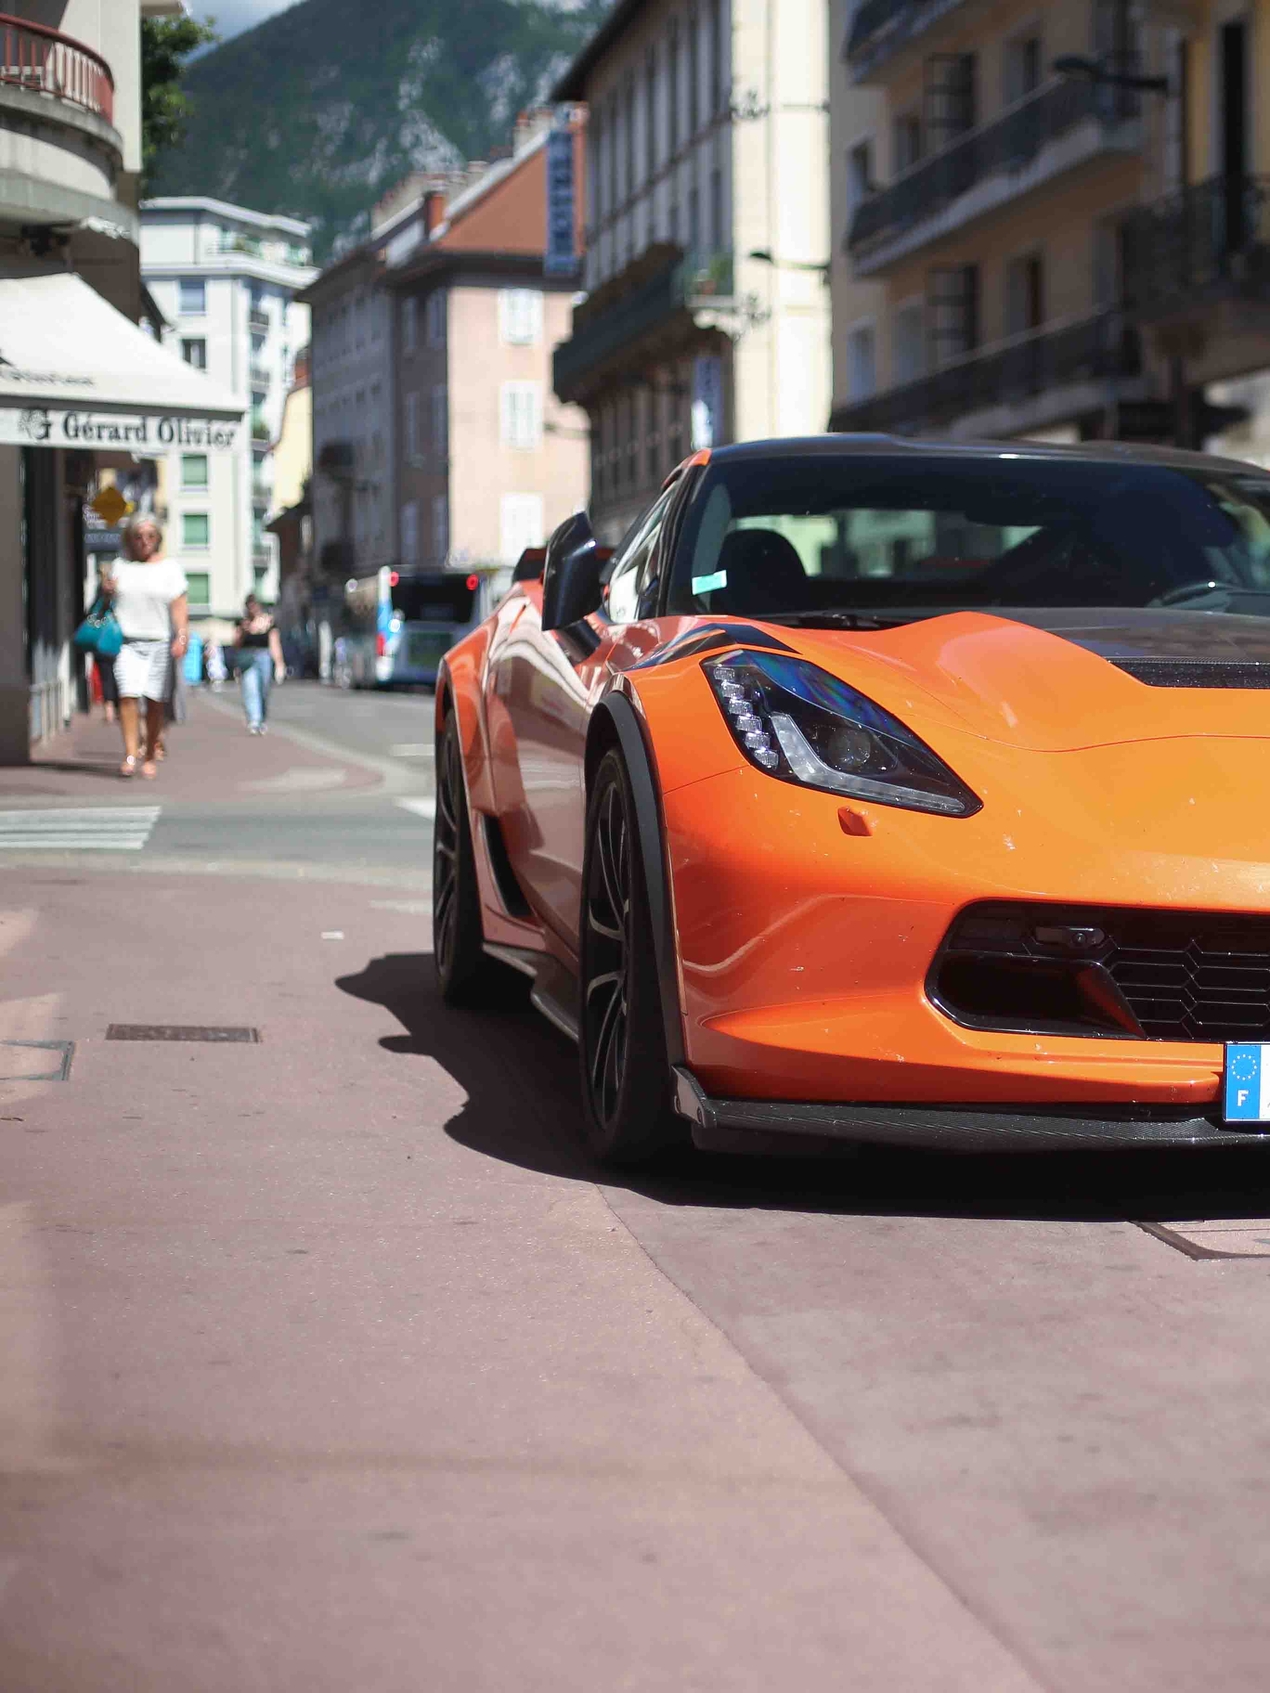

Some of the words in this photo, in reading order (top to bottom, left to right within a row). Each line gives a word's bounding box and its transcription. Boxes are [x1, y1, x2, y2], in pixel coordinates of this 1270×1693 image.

[63, 409, 147, 443] Gérard
[157, 414, 235, 447] Olivier
[1237, 1090, 1249, 1107] F
